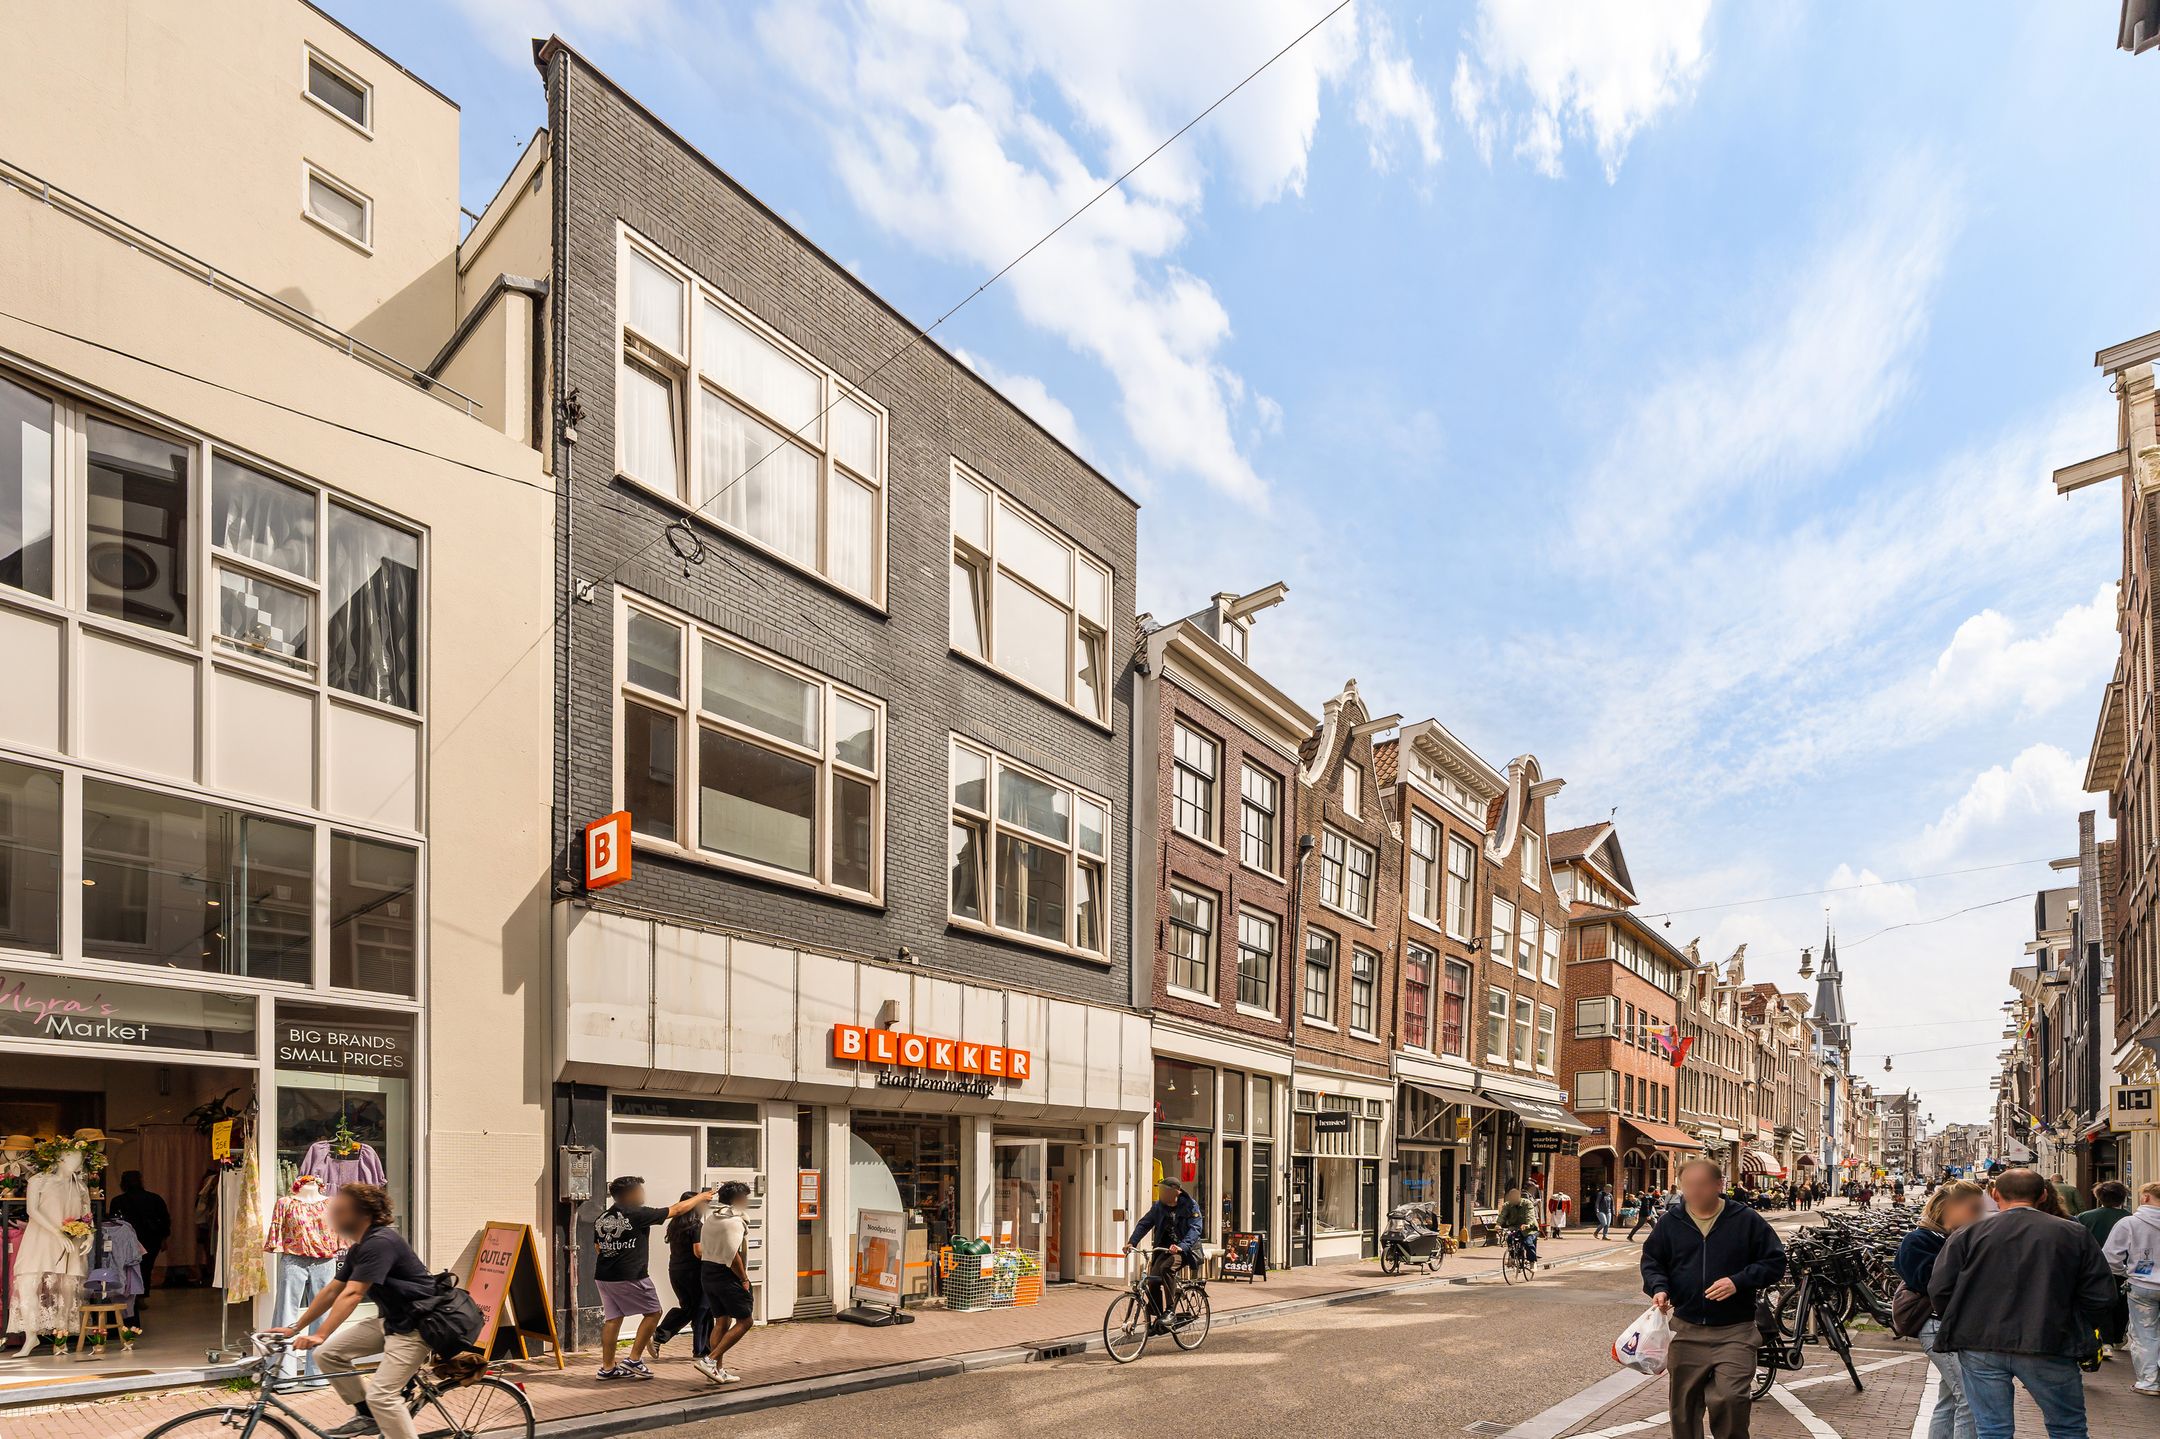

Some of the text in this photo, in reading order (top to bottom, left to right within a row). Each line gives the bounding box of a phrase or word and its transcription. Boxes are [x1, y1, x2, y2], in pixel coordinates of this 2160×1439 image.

[594, 831, 611, 870] B
[44, 1014, 150, 1041] Market
[289, 1029, 396, 1050] BIG BRANDS
[280, 1046, 404, 1067] SMALL PRICES
[842, 1028, 1028, 1076] BLOKKER
[877, 1069, 995, 1100] Haarlemmerdijk
[1227, 1113, 1236, 1123] 70
[1184, 1147, 1197, 1164] 24
[1532, 1143, 1558, 1151] vintage
[866, 1223, 897, 1236] Noodpakket
[480, 1249, 512, 1267] OUTLET
